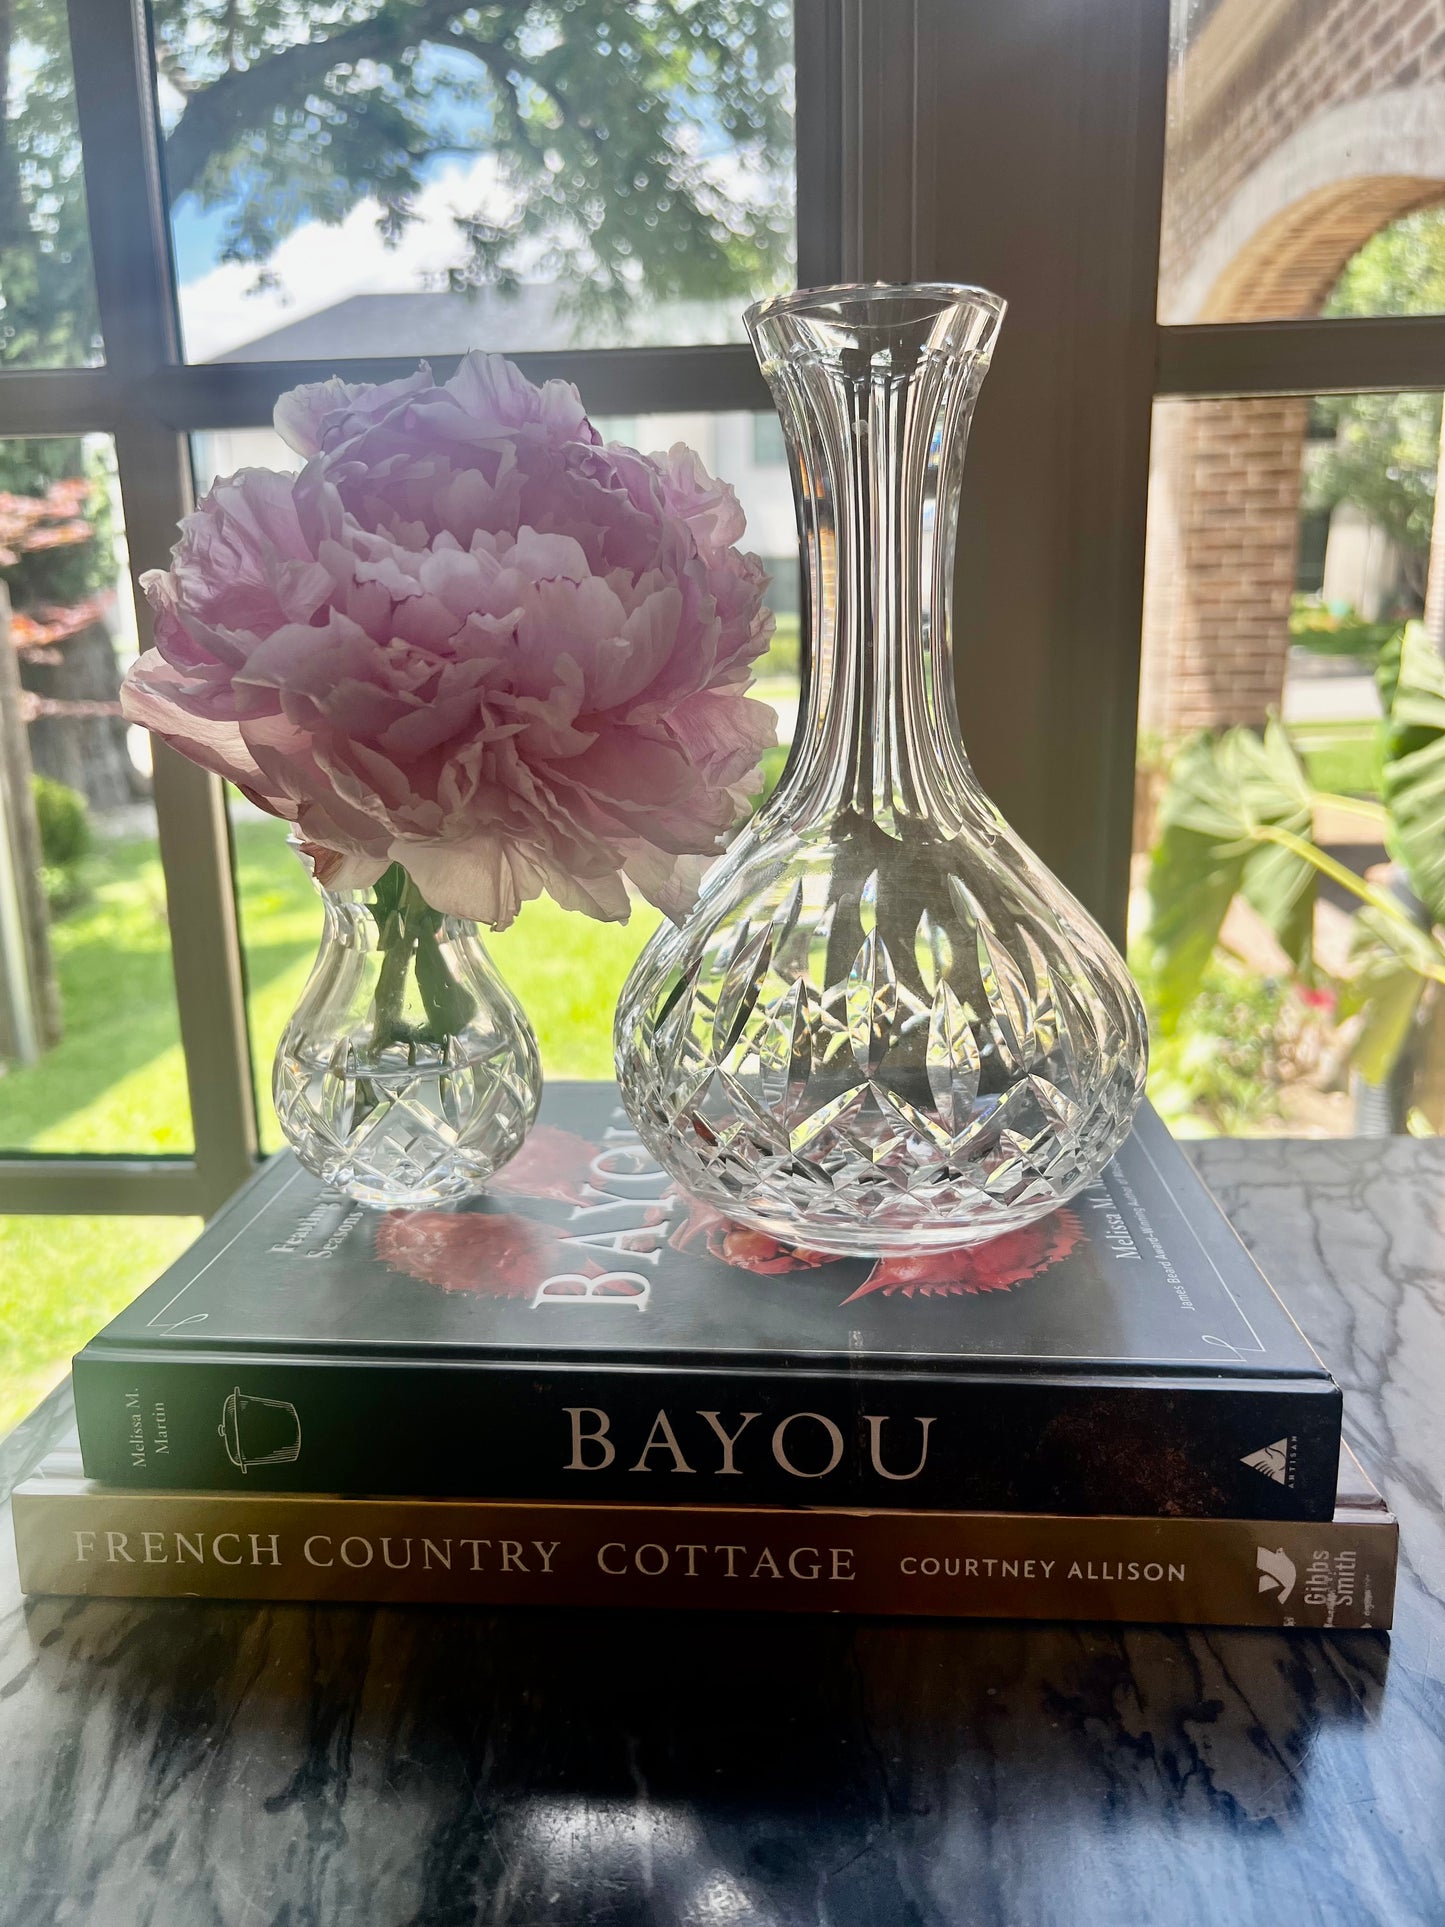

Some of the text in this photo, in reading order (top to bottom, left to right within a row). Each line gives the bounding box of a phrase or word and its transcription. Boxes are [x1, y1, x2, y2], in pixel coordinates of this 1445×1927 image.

[1089, 1194, 1117, 1209] M.
[305, 1210, 365, 1259] Seasons
[1105, 1213, 1142, 1260] Melissa
[1158, 1261, 1181, 1284] Beard
[1173, 1285, 1196, 1311] James
[125, 1387, 147, 1468] Melissa M.
[152, 1402, 170, 1455] Martin
[563, 1406, 939, 1482] BAYOU
[1288, 1435, 1298, 1489] ARTISAN
[73, 1530, 857, 1582] FRENCH COUNTRY COTTAGE
[900, 1556, 1186, 1583] COURTNEY ALLISON
[1303, 1550, 1329, 1605] Gibbs
[1334, 1550, 1357, 1606] Smith
